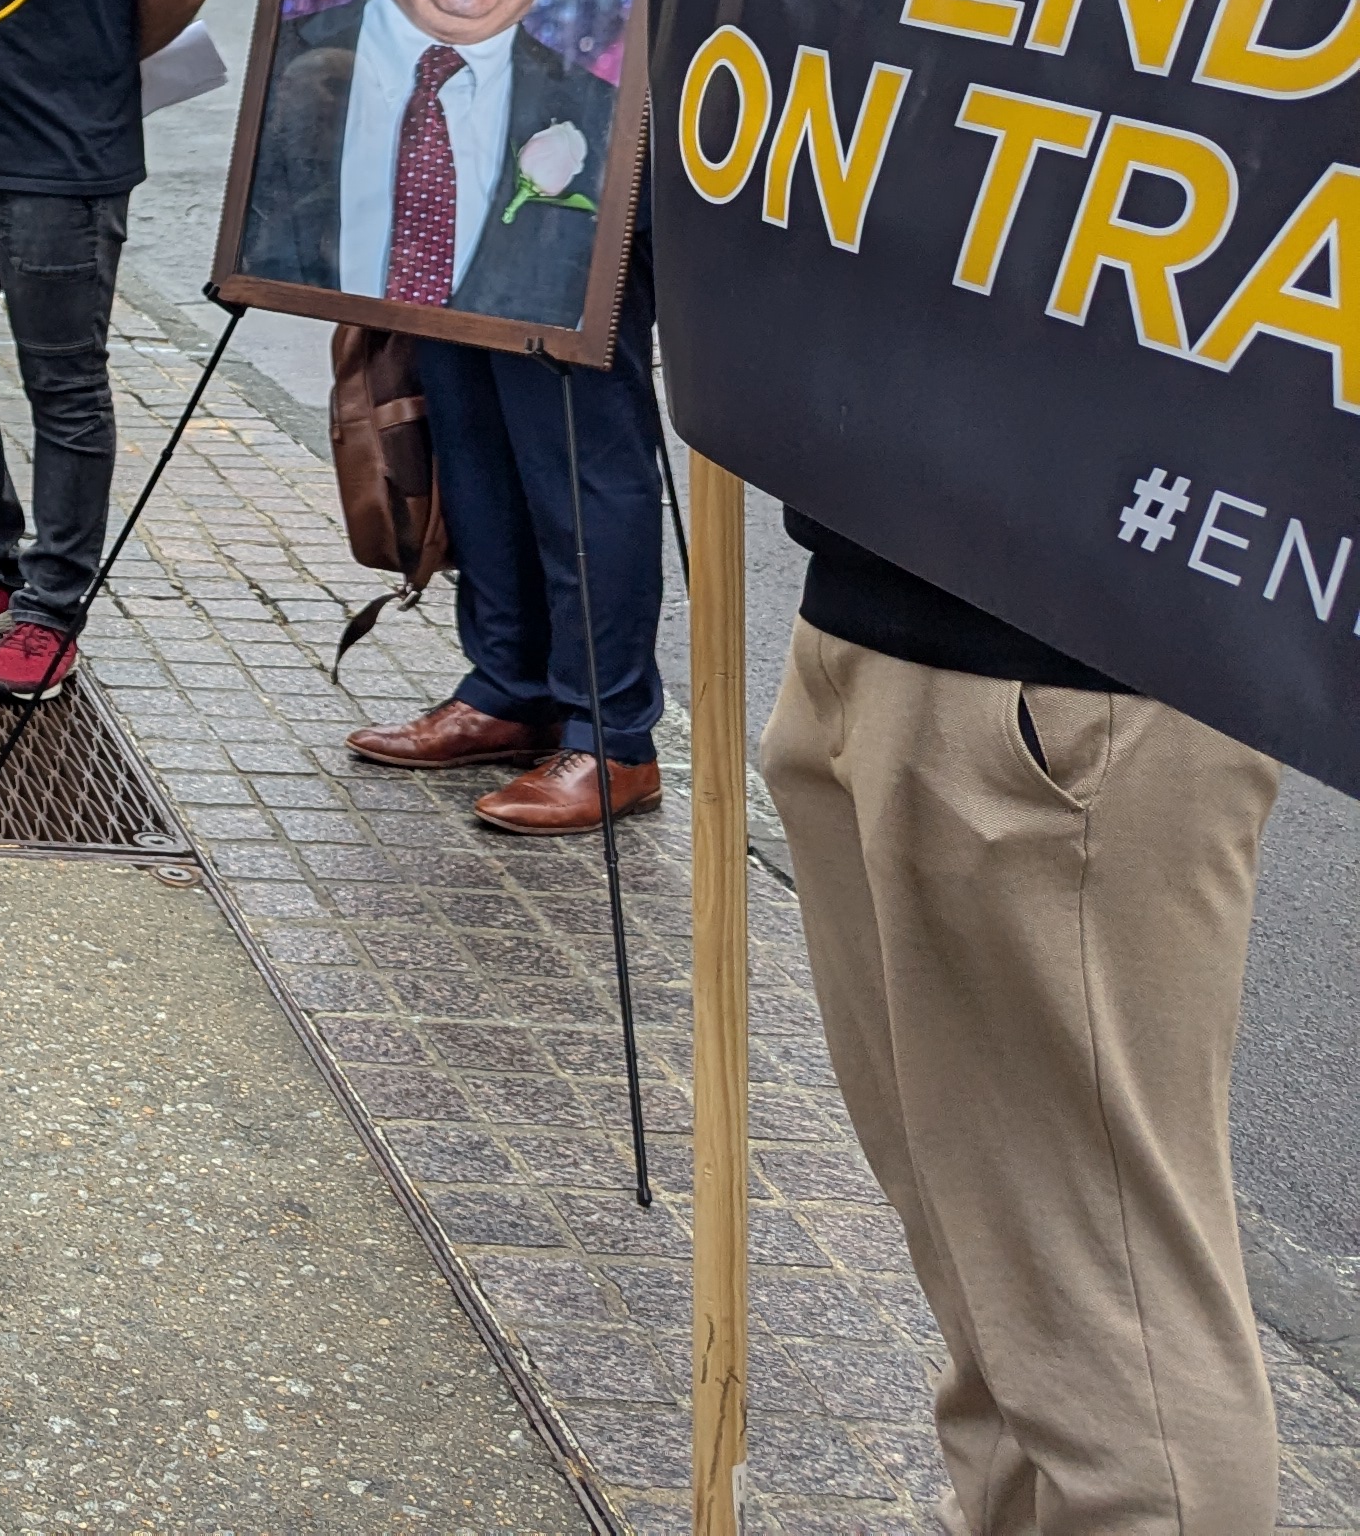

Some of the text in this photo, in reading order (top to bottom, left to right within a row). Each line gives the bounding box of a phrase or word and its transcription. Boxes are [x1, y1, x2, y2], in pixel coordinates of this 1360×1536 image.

[678, 24, 1360, 416] ON TRA
[1117, 466, 1360, 636] #EN
